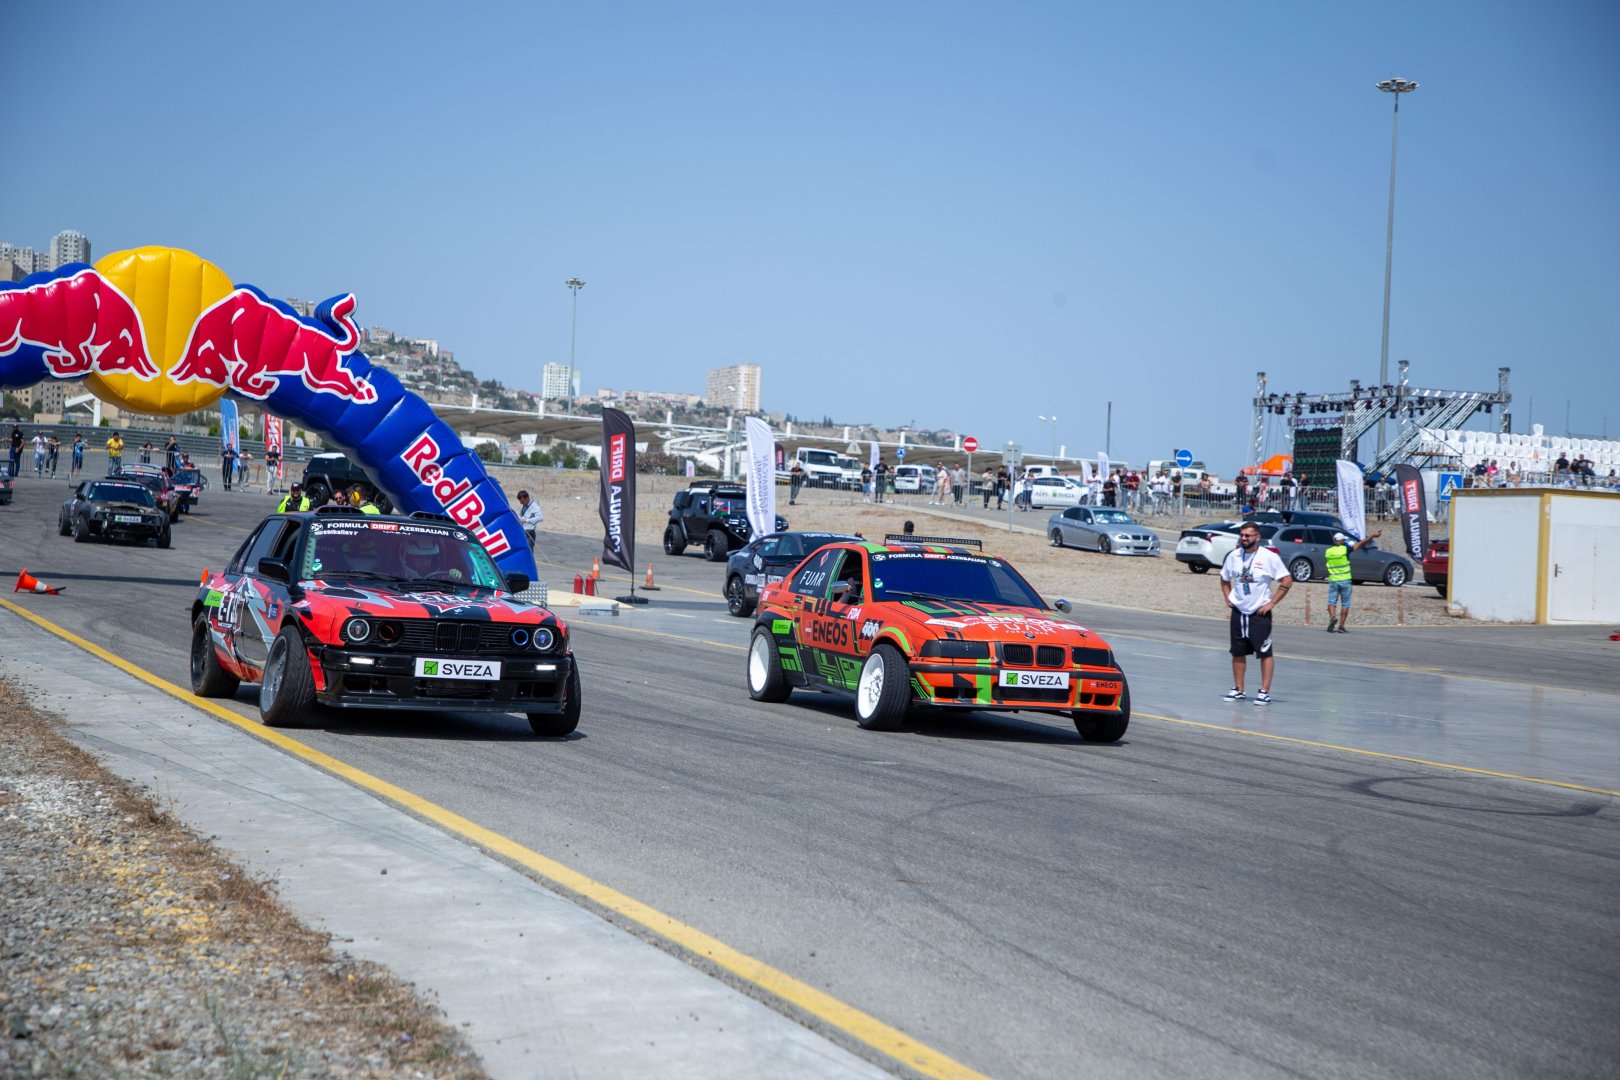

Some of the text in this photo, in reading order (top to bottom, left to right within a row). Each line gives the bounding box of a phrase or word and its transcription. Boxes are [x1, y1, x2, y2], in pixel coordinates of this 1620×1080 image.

[402, 434, 510, 557] Red Bull
[799, 570, 826, 587] FUAR
[812, 620, 848, 646] ENEOS
[442, 663, 493, 677] SVEZA
[1021, 674, 1062, 686] SVEZA
[1096, 681, 1118, 689] ENEOS
